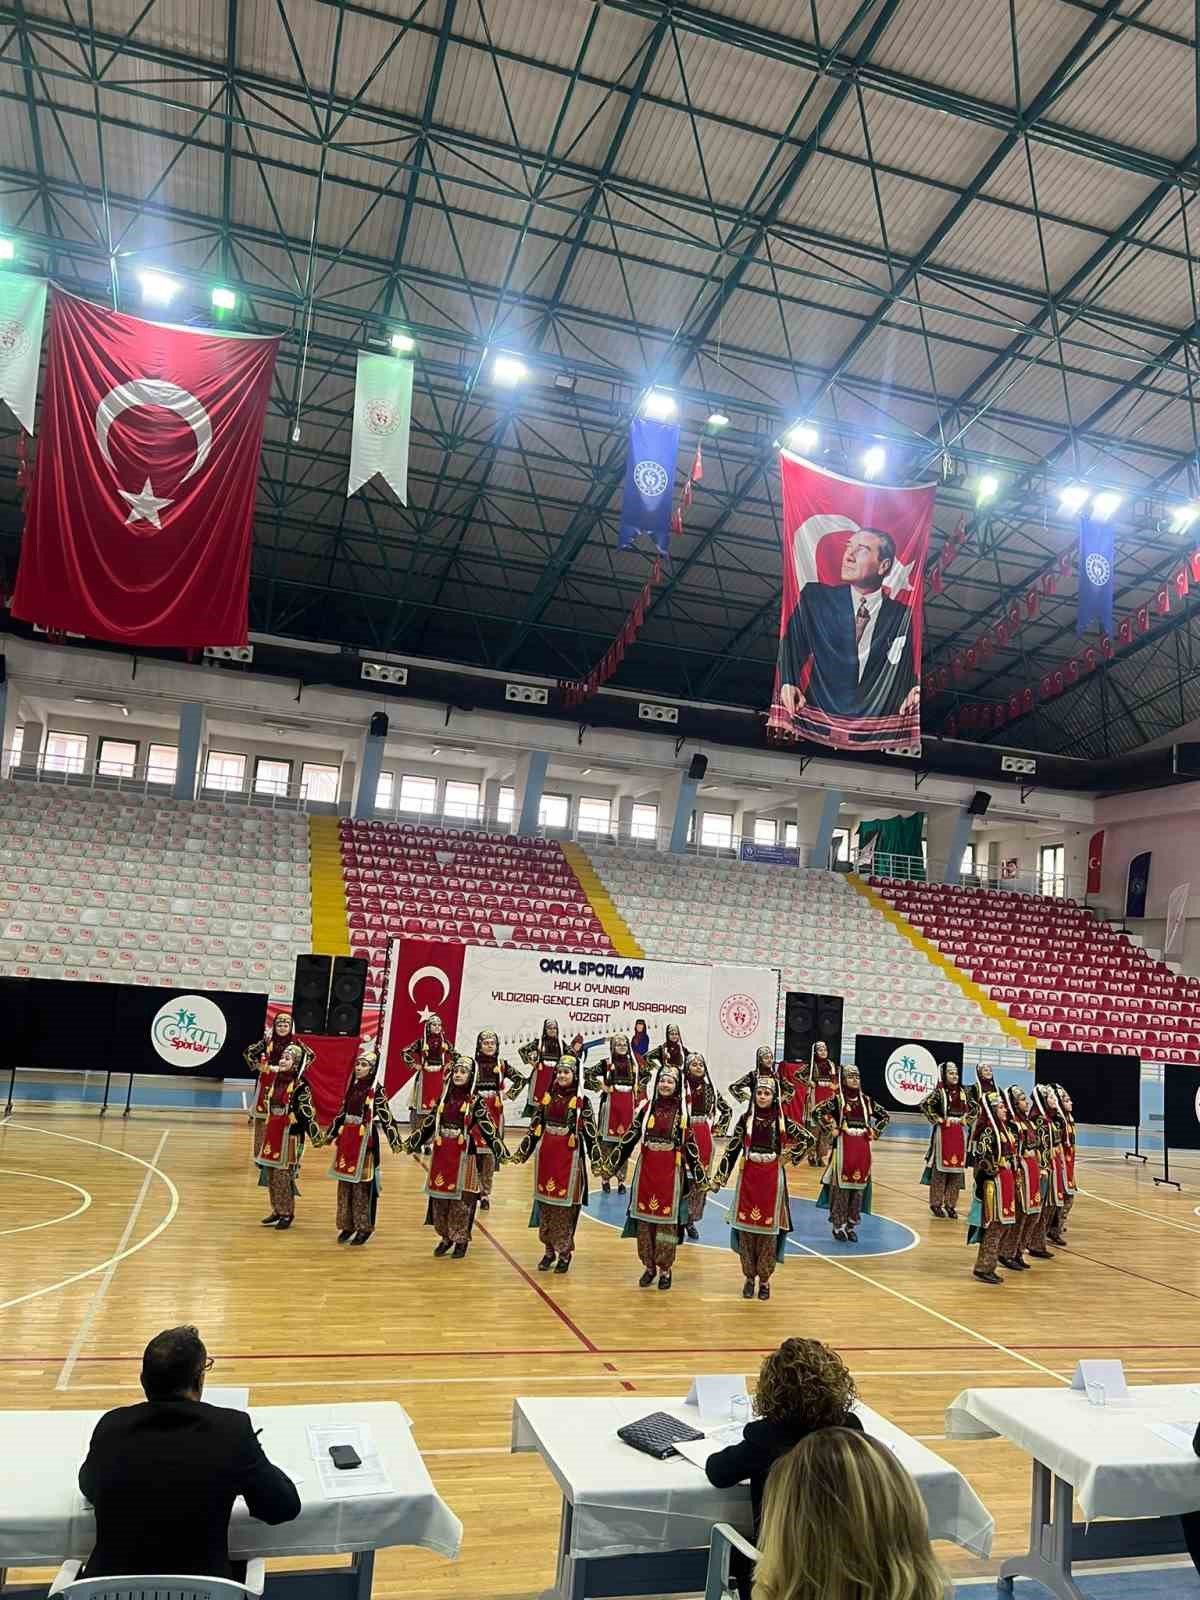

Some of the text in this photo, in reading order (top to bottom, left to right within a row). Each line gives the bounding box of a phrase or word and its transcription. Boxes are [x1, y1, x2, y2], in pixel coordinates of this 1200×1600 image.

[540, 958, 645, 980] OKUL SPORLARI
[553, 980, 630, 996] HALK OYUNLARI
[592, 998, 620, 1010] GRUP
[568, 1011, 611, 1024] YOZGAT
[160, 1021, 221, 1050] OKUL
